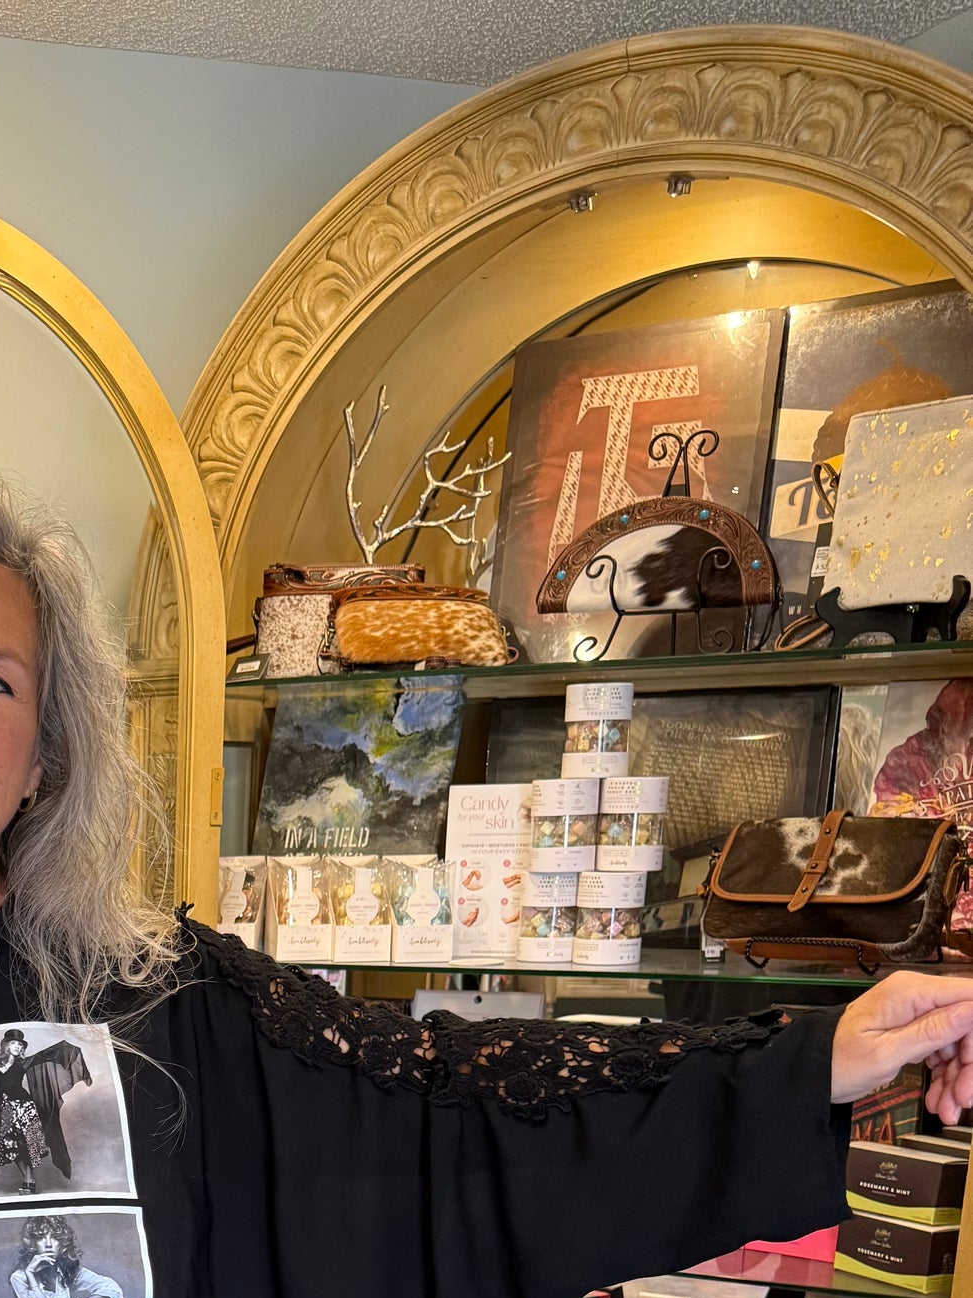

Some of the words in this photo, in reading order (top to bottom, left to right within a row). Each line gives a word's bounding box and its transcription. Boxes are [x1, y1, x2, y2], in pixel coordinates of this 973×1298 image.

[460, 795, 509, 815] Candy
[485, 815, 514, 829] skin
[284, 827, 302, 849] IN
[306, 827, 317, 849] A
[323, 826, 370, 848] FIELD
[859, 1181, 889, 1192] ROSEMARY
[896, 1188, 911, 1197] MINT
[857, 1247, 884, 1258] ROSEMARY
[890, 1256, 903, 1264] MINT
